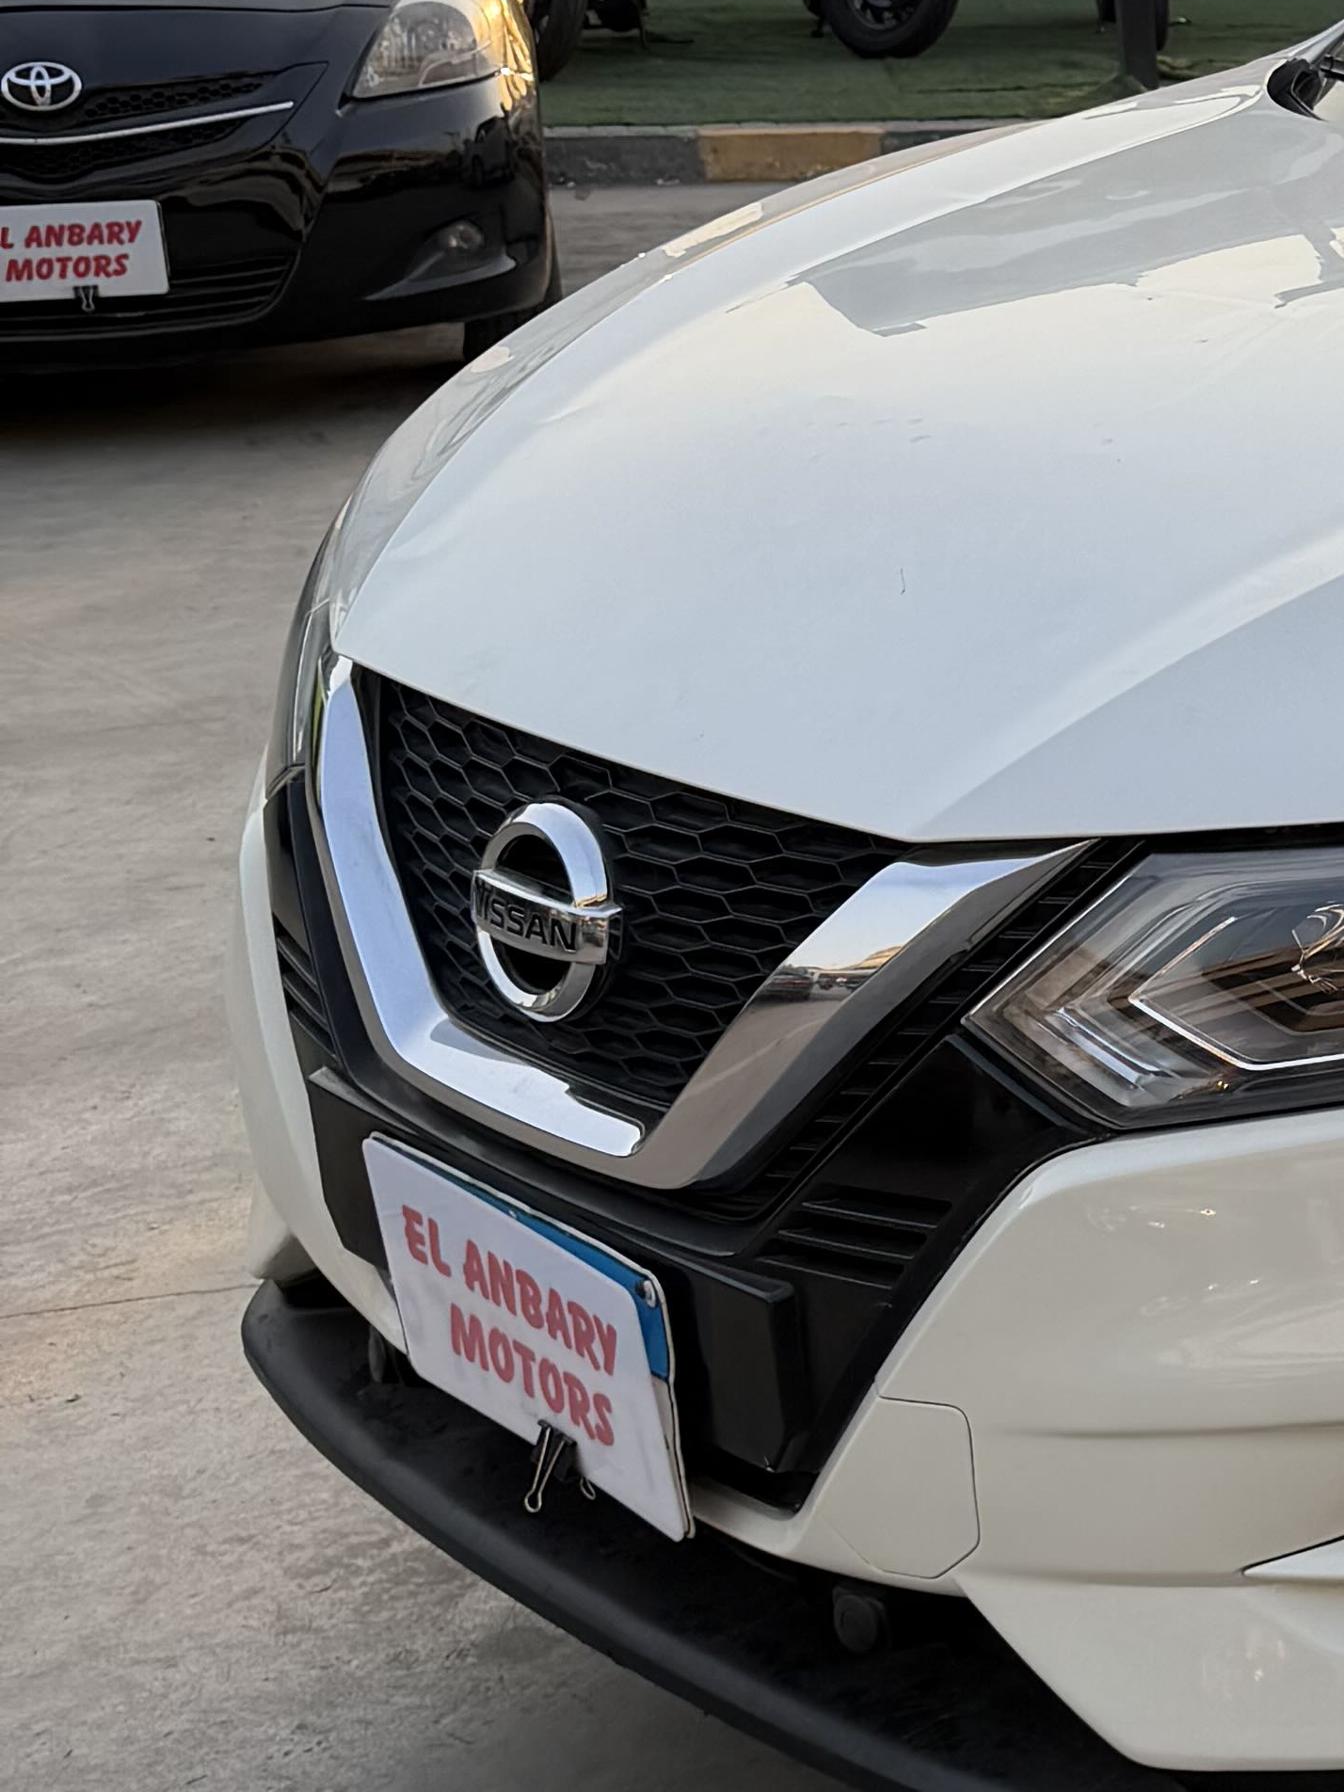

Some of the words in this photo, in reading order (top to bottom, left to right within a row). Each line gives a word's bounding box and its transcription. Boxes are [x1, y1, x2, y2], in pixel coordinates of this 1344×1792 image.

[0, 227, 15, 249] L
[24, 220, 142, 249] ANBARY
[5, 253, 130, 283] MOTORS
[474, 875, 577, 953] NISSAN
[402, 1204, 452, 1278] EL
[463, 1239, 617, 1376] ANBARY
[451, 1302, 615, 1446] MOTORS
